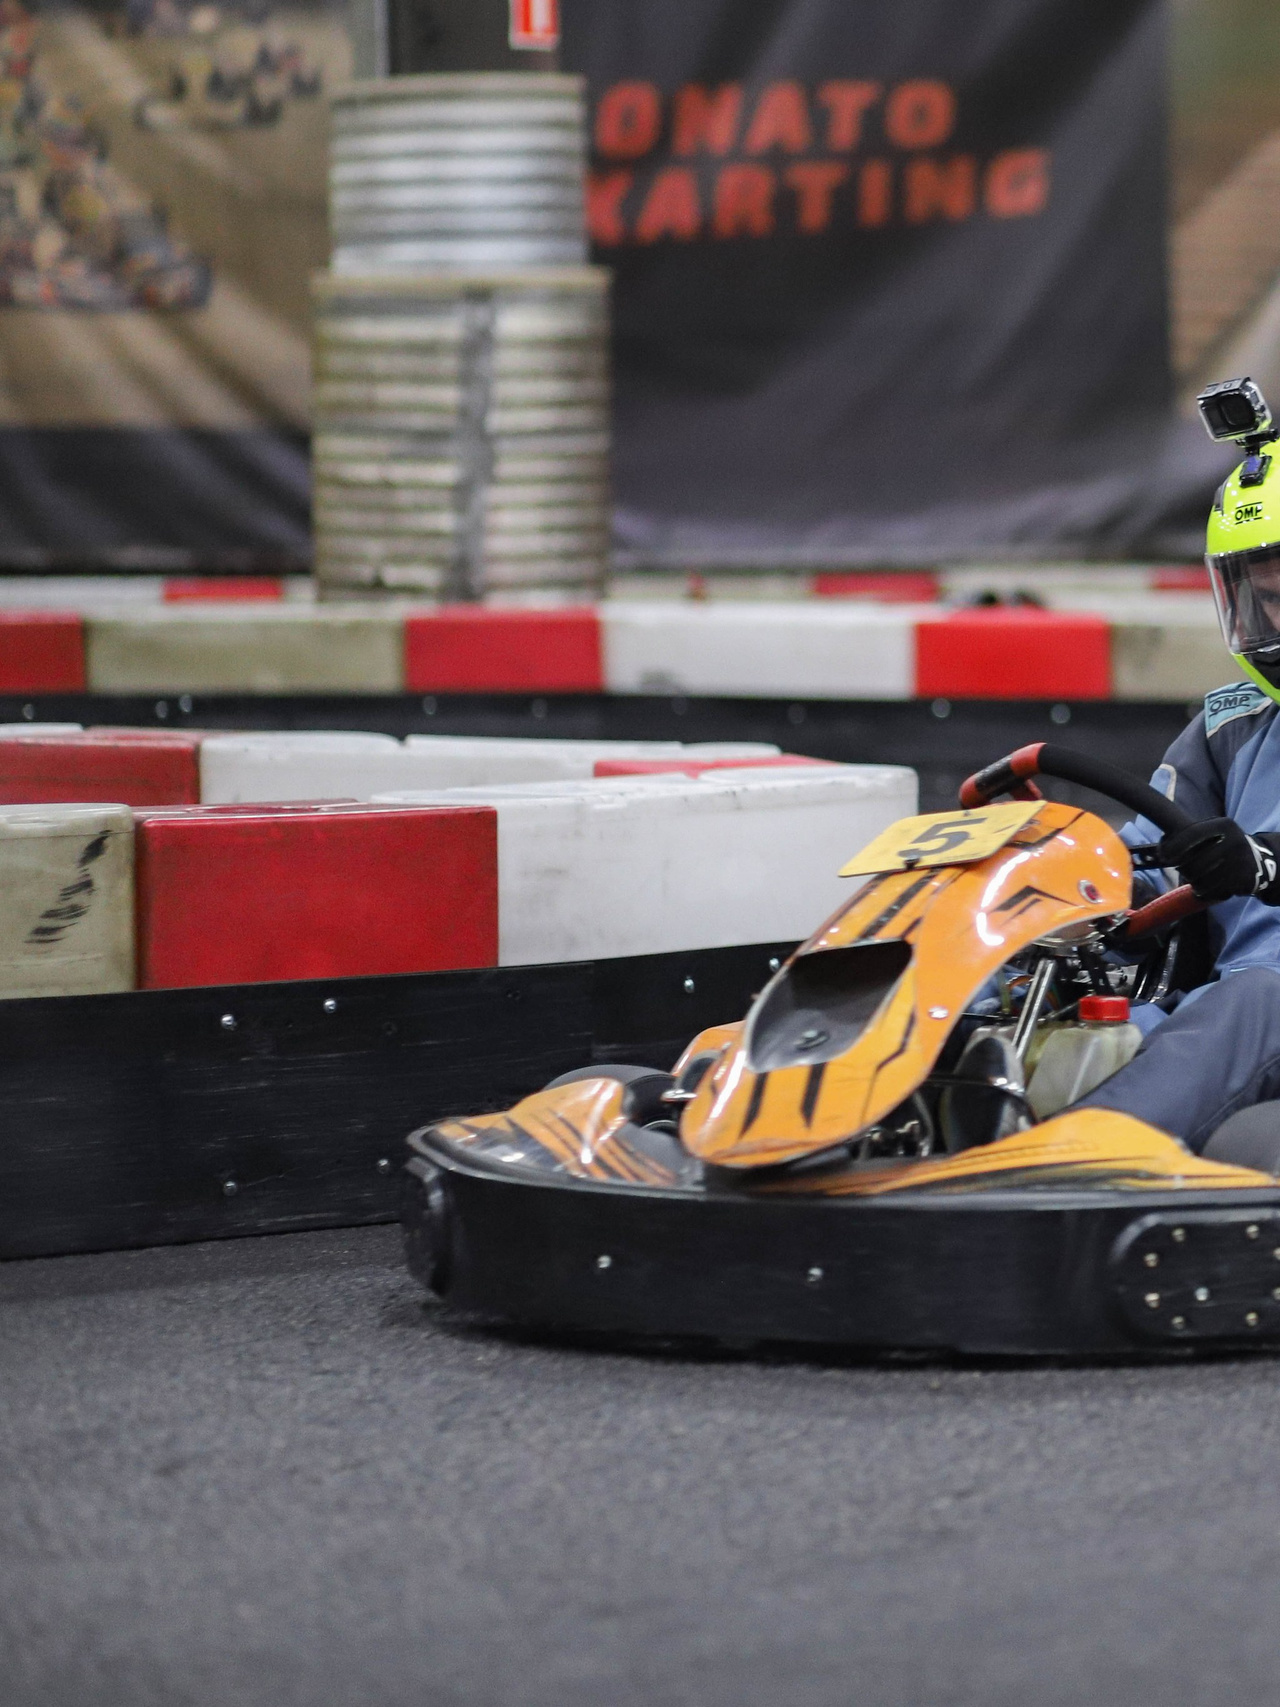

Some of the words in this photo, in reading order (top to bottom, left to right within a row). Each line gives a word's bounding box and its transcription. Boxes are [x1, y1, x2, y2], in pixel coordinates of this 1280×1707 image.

[1234, 505, 1262, 521] OMP
[1210, 695, 1250, 713] OMP
[897, 817, 988, 858] 5
